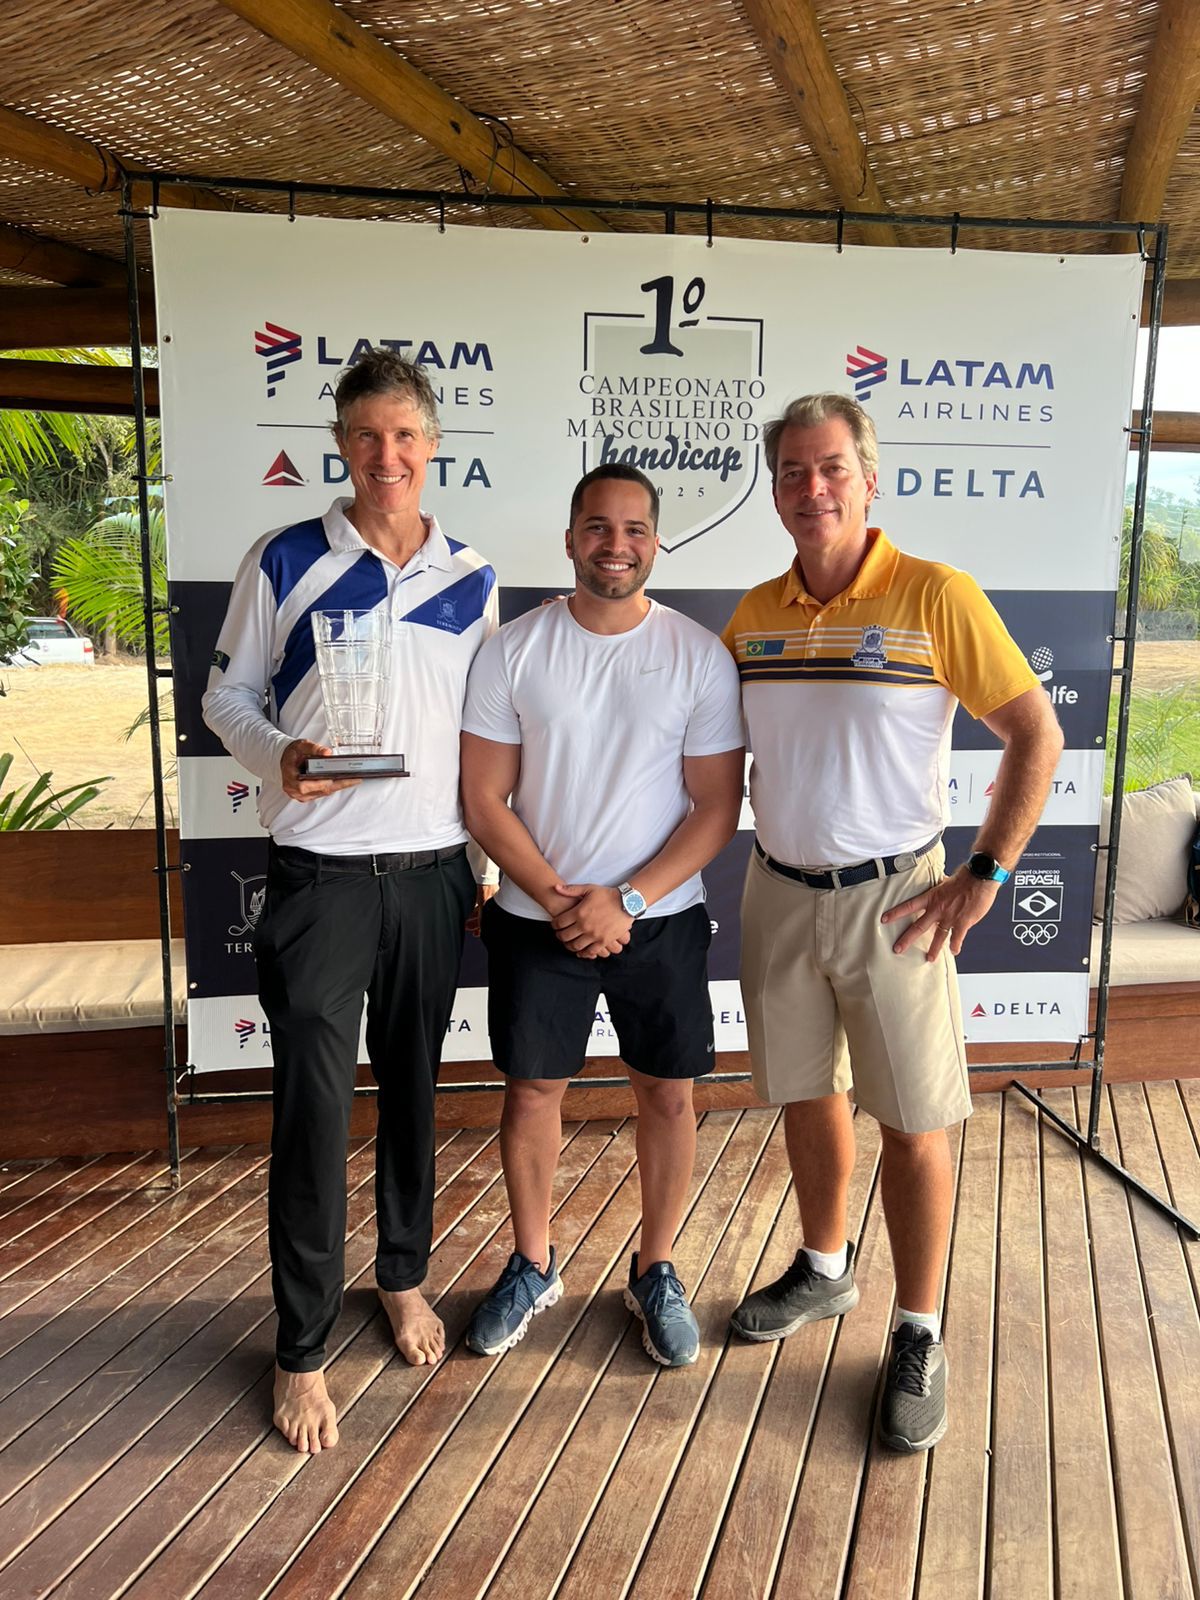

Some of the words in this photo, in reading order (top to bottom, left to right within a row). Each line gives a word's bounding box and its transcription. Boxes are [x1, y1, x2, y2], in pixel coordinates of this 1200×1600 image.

[900, 358, 1055, 390] LATAM
[579, 374, 766, 399] CAMPEONATO
[591, 397, 753, 420] BRASILEIRO
[898, 401, 1053, 422] AIRLINES
[567, 418, 731, 441] MASCULINO
[600, 434, 743, 482] handicap
[323, 453, 492, 488] DTA
[896, 467, 1045, 498] DELTA
[1014, 874, 1064, 885] BRASIL
[994, 1002, 1061, 1015] DELTA
